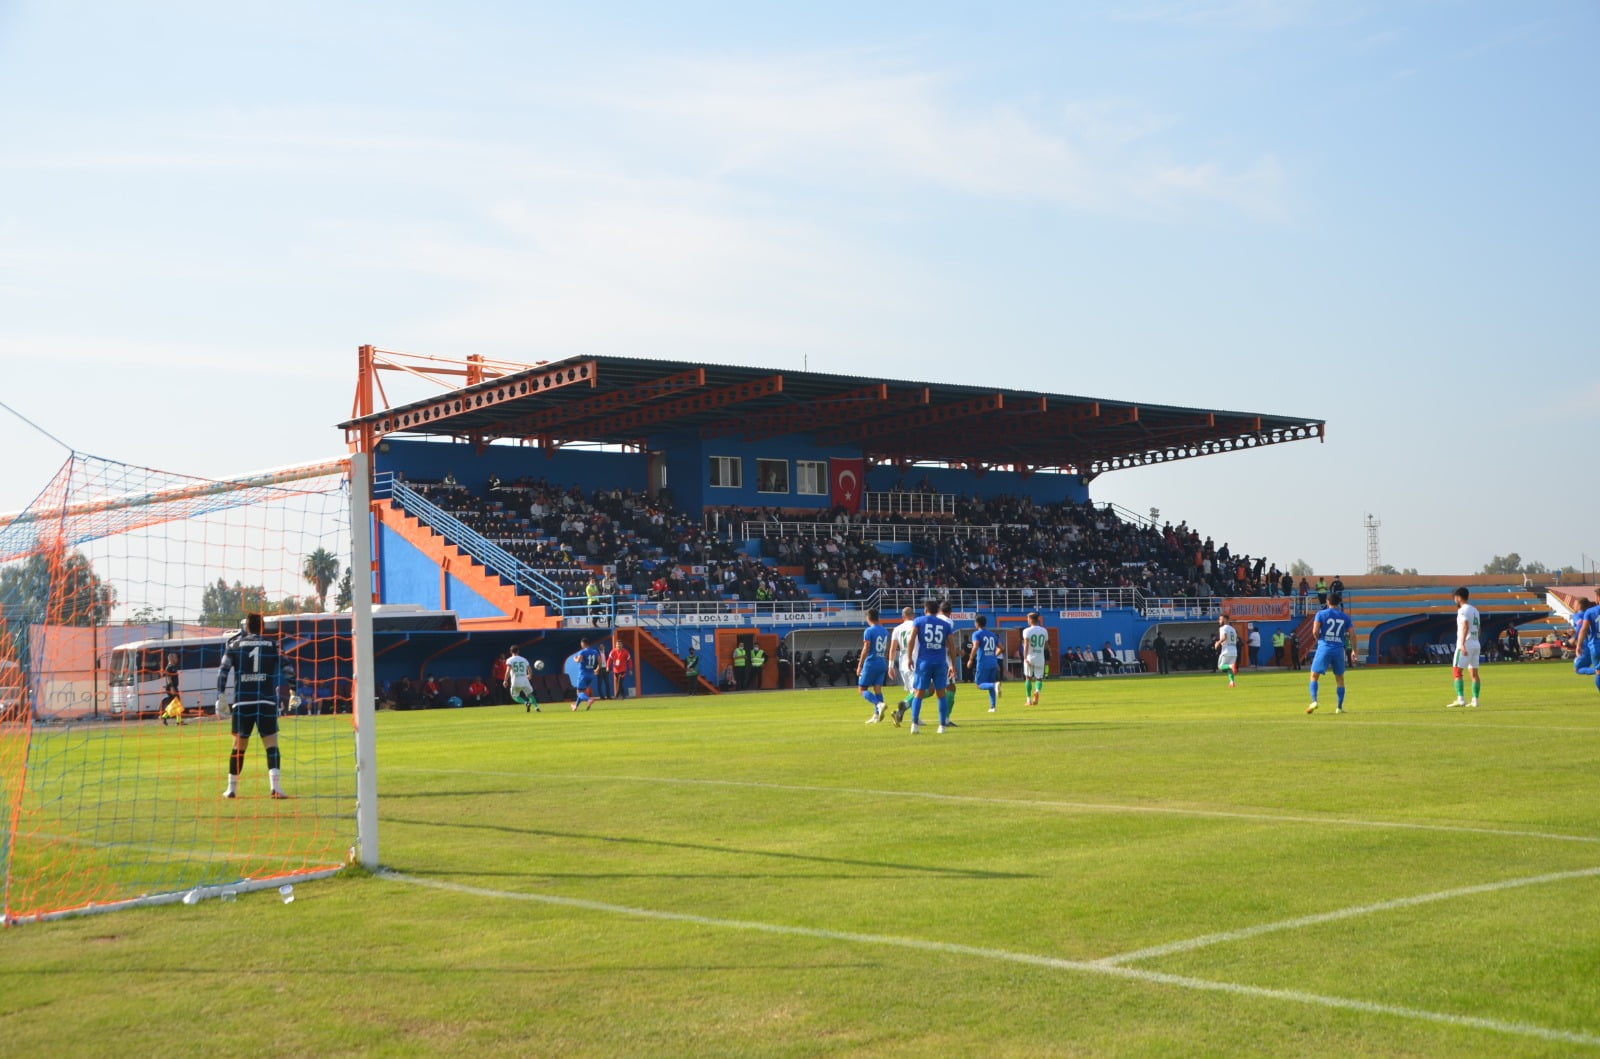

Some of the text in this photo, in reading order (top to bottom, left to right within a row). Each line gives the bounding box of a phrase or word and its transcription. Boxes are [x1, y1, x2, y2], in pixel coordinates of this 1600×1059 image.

[784, 613, 806, 621] LOCA
[924, 623, 944, 644] 55
[1325, 618, 1345, 637] 27
[875, 635, 888, 653] 64
[983, 636, 996, 651] 20
[1030, 634, 1045, 648] 90
[248, 646, 260, 673] 1
[512, 661, 526, 673] 55
[587, 654, 597, 666] 11
